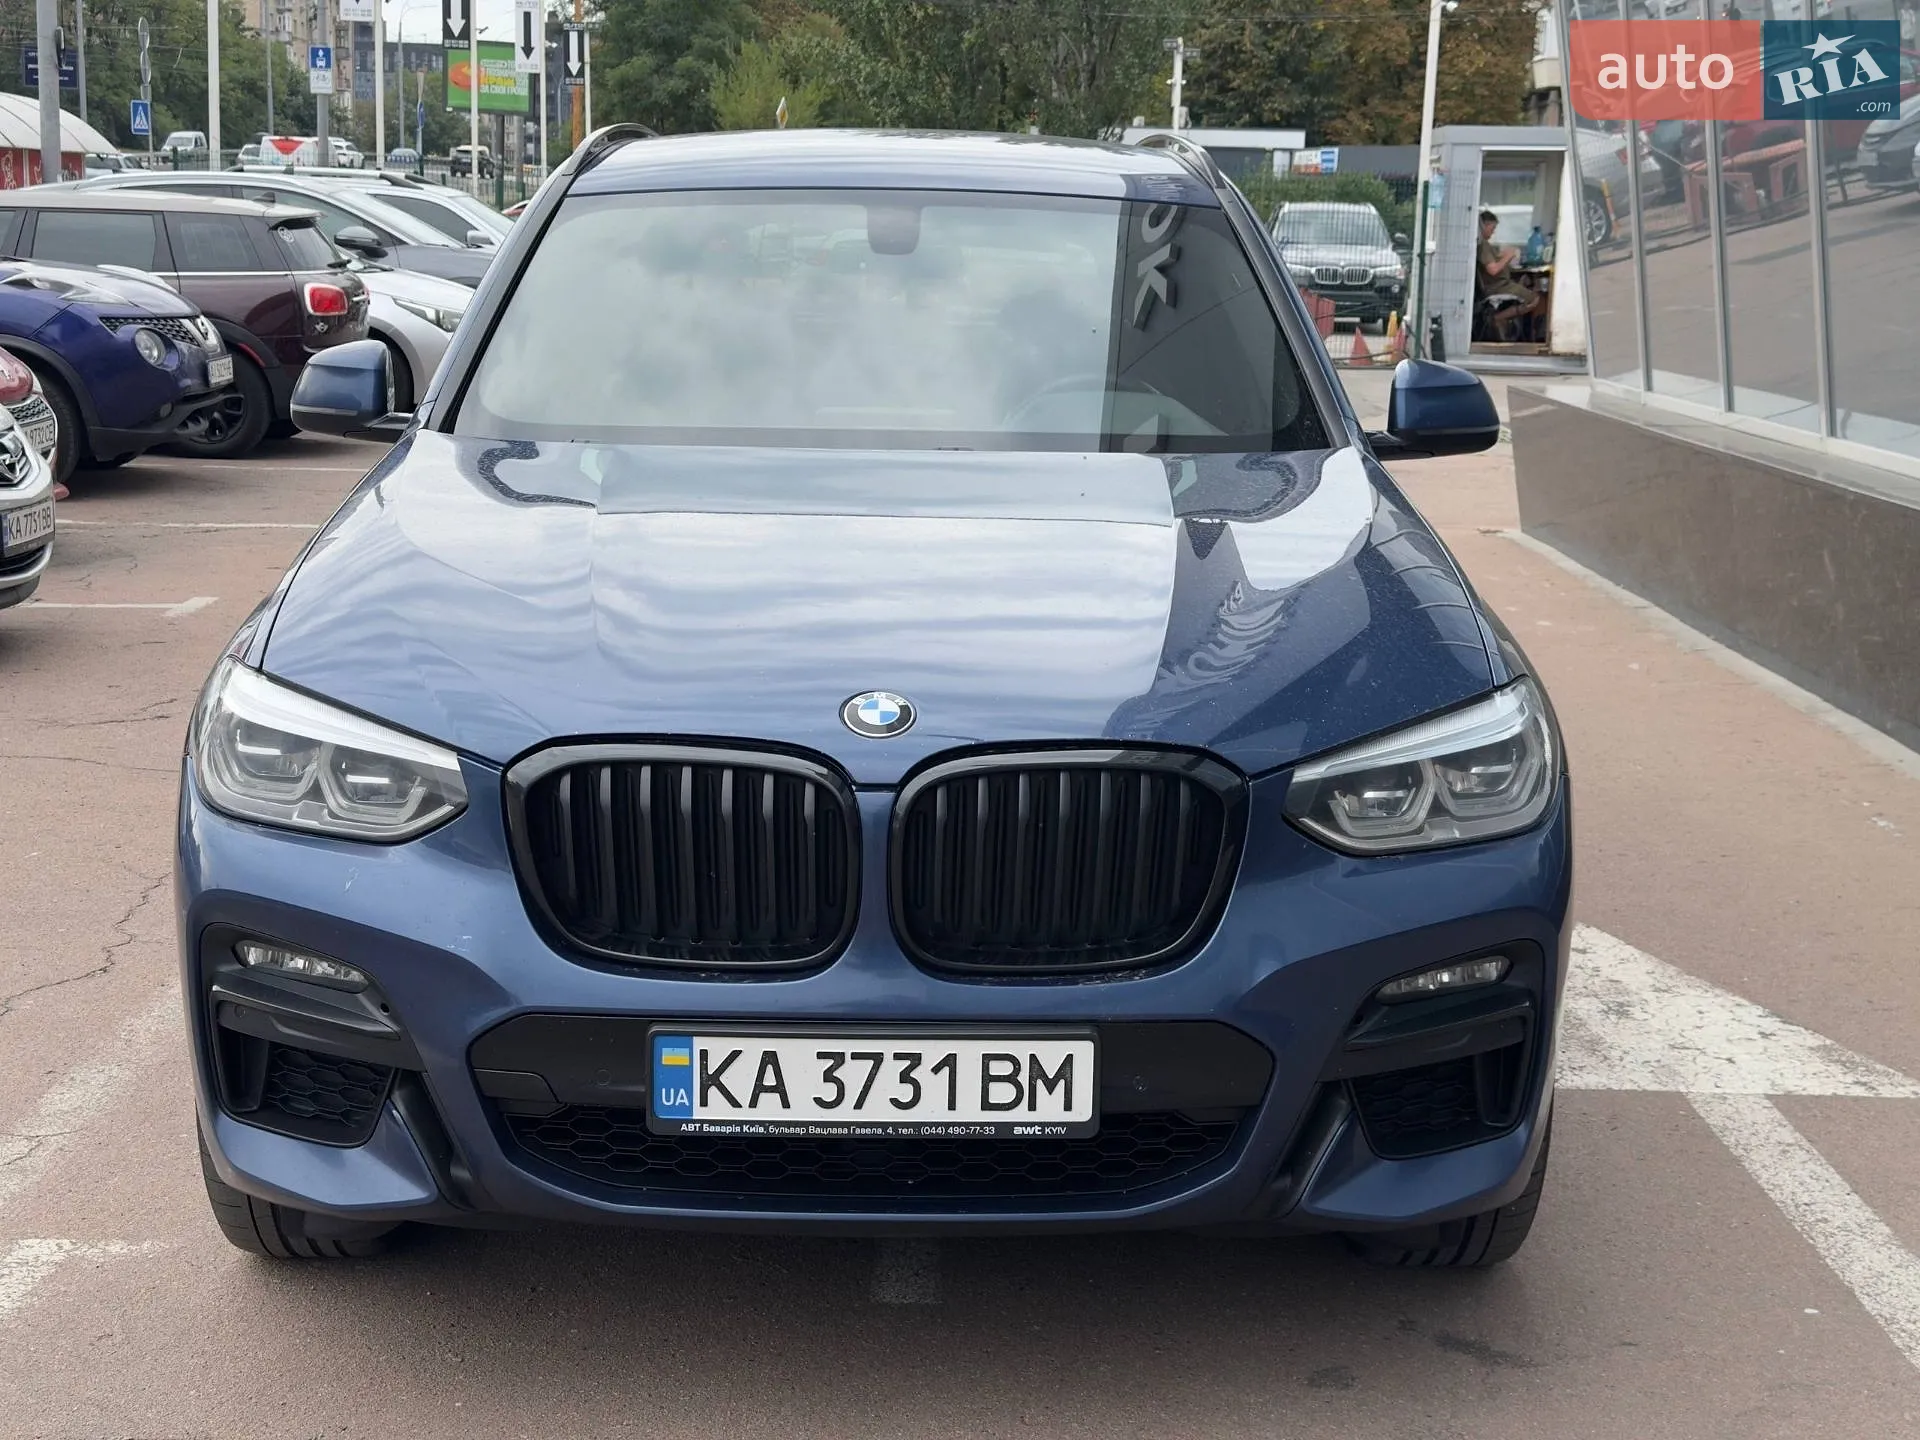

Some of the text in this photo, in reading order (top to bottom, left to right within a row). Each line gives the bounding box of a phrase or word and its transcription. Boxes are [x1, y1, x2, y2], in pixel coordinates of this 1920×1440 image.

[698, 1048, 1075, 1113] KA 3731 BM
[661, 1087, 690, 1107] UA
[703, 1123, 741, 1134] Баварія
[768, 1125, 807, 1136] бульвар
[808, 1126, 849, 1136] Вацлава
[850, 1126, 885, 1136] Гавела,
[920, 1126, 946, 1137] (044)
[947, 1126, 996, 1136] 490-77-33
[1013, 1126, 1067, 1136] awt KYIV
